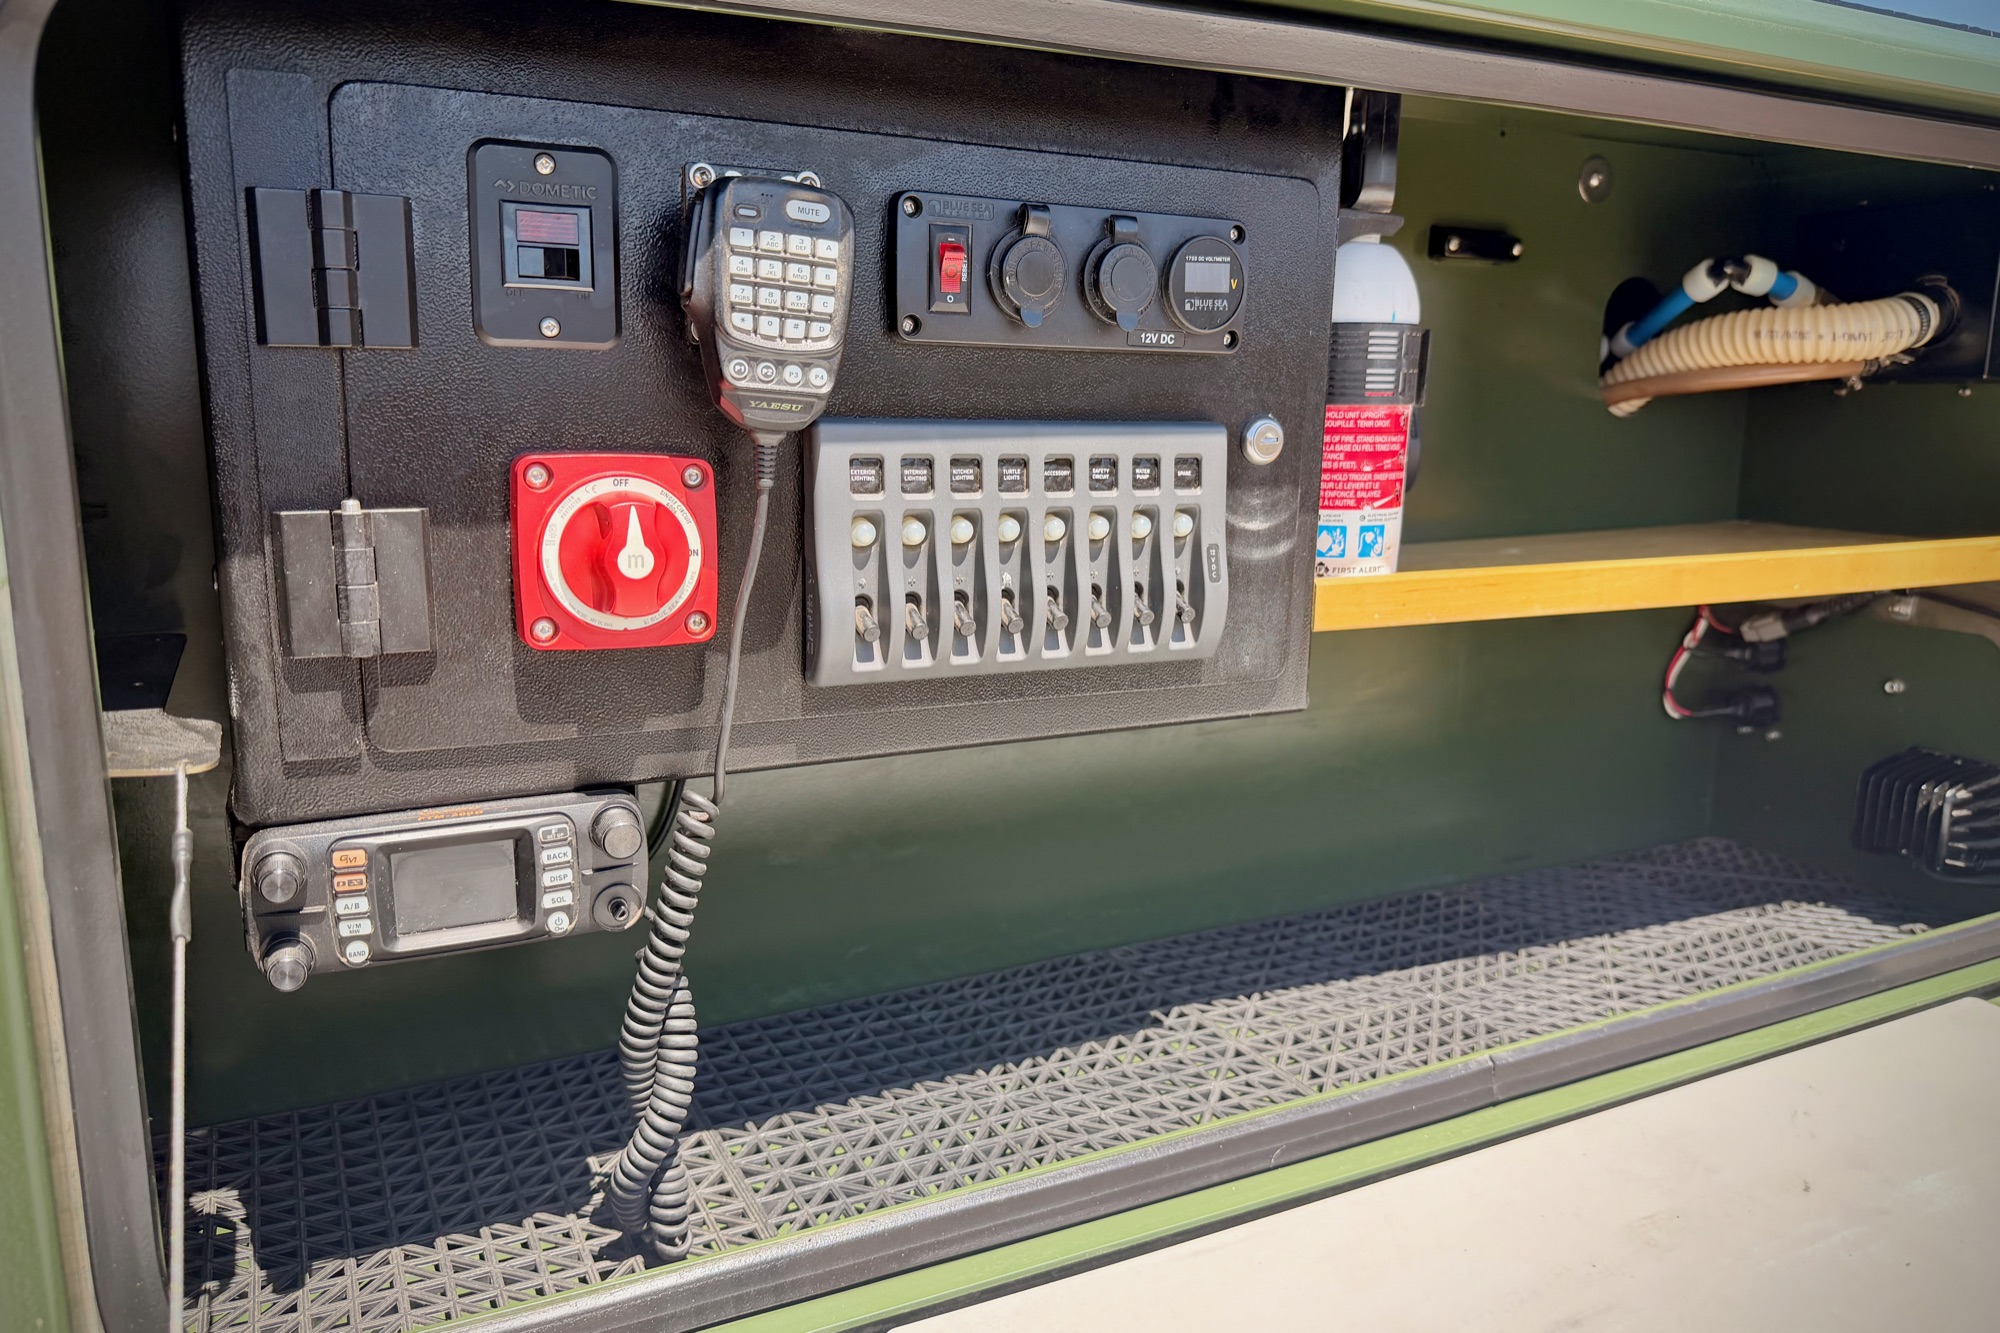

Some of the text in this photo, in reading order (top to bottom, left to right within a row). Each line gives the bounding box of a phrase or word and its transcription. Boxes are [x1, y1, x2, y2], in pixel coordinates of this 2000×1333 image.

[518, 181, 598, 200] DOMETIC
[942, 200, 991, 213] BLUE SEA
[797, 206, 820, 217] MUTE
[825, 244, 832, 252] A
[736, 265, 749, 273] GHI
[765, 269, 778, 277] JKL
[824, 273, 831, 281] B
[1230, 278, 1239, 290] V
[764, 297, 778, 305] TUV
[790, 301, 807, 309] WXYZ
[1195, 299, 1229, 307] BLUE SEA
[1139, 332, 1175, 345] 12V DC
[735, 365, 746, 373] P1
[761, 368, 774, 376] P2
[814, 373, 825, 381] P4
[749, 400, 804, 411] YAESU
[1326, 411, 1386, 419] HOLD UNIT UPRIGHT.
[1357, 420, 1373, 428] TENIR
[1332, 435, 1341, 443] OF
[1356, 435, 1374, 443] STAND
[1331, 473, 1348, 481] HOLD
[612, 478, 630, 487] OFF
[1343, 481, 1365, 489] LEVIER
[1373, 481, 1380, 489] LE
[1356, 490, 1381, 498] BALAYEZ
[557, 495, 575, 515] IGNITION
[659, 489, 693, 526] SINGLE CIRCUIT
[688, 548, 699, 557] ON
[627, 553, 645, 569] m
[1331, 566, 1356, 574] FIRST
[650, 608, 670, 623] BLUE
[668, 599, 680, 612] SEA
[546, 851, 569, 861] BACK
[550, 873, 568, 883] DISP
[551, 895, 567, 905] SQL
[343, 902, 360, 911] A/B
[347, 922, 362, 930] V/M
[348, 950, 366, 958] BAND
